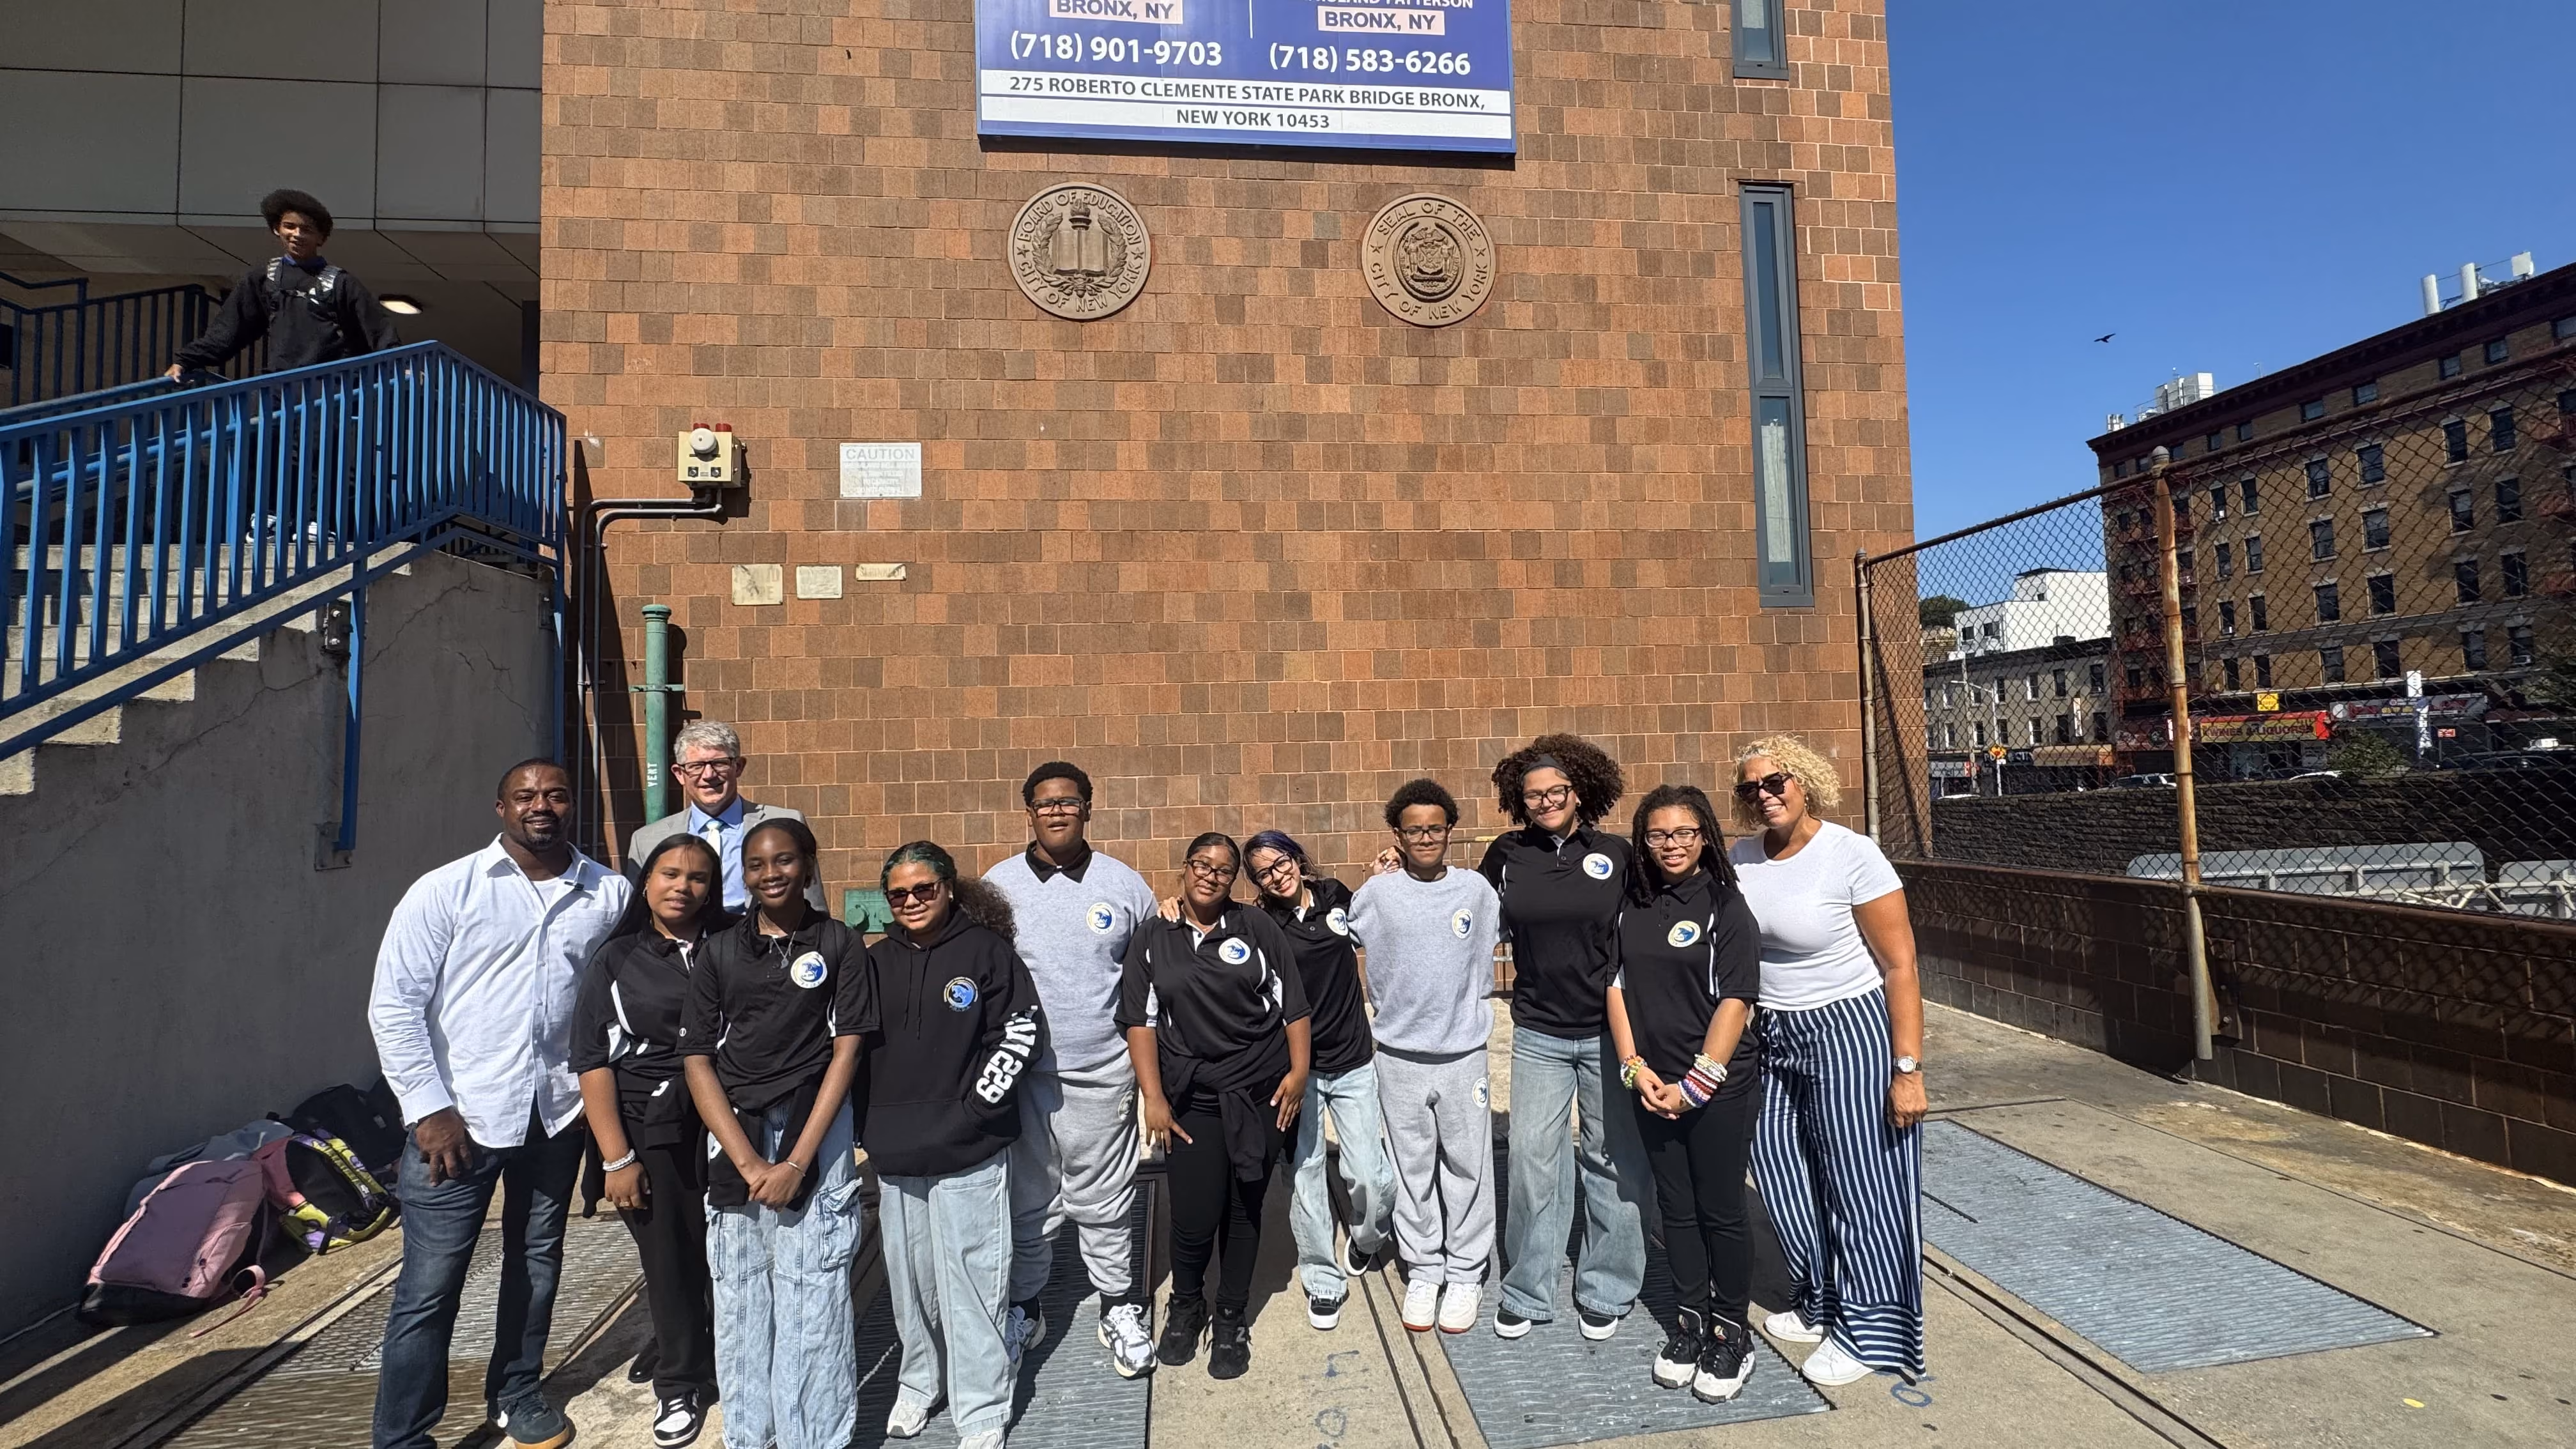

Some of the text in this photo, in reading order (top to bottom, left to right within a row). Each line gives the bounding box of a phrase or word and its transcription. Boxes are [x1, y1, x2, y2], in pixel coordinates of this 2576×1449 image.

[1057, 0, 1174, 20] BRONX, NY
[1324, 11, 1436, 31] BRONX, NY
[1011, 31, 1222, 66] (718) 901-9703
[1269, 42, 1471, 75] (718) 583-6266
[1009, 77, 1485, 110] 275 ROBERTO CLEMENTE STATE PARK BRIDGE BRONX,
[1177, 109, 1330, 128] NEW YORK 10453
[1016, 191, 1142, 245] BOARD OF EDUCATION
[1377, 203, 1480, 241] SEAL OF THE
[1019, 261, 1142, 312] CITY OF NEW YORK
[1370, 263, 1399, 299] CITY
[1399, 301, 1422, 316] OF
[1429, 299, 1462, 319] NEW
[1462, 263, 1487, 302] YORK
[846, 448, 915, 460] CAUTION
[976, 1050, 1023, 1104] 229
